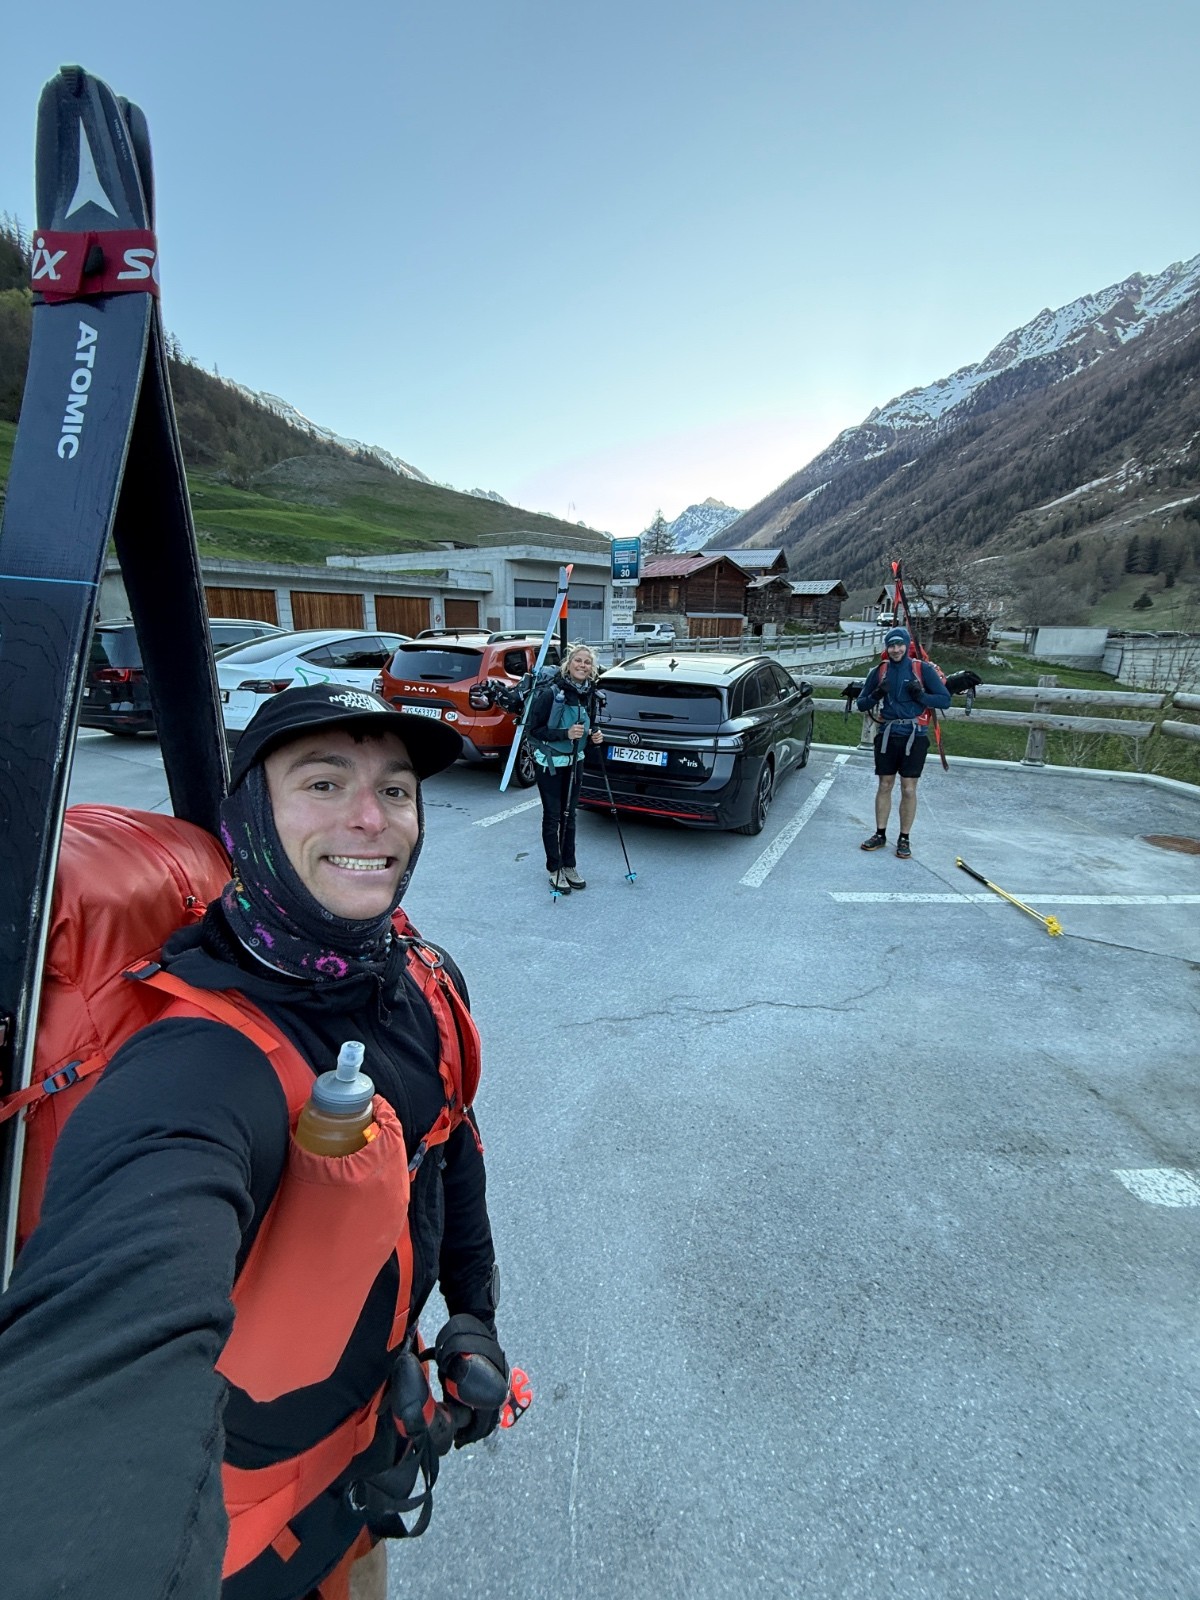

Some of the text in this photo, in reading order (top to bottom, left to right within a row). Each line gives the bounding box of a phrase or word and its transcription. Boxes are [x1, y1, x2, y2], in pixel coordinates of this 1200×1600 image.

[57, 320, 98, 460] ATOMIC
[620, 568, 631, 578] 30
[404, 685, 437, 693] DACIA
[345, 690, 368, 699] THE
[329, 694, 371, 706] NORTH
[344, 700, 373, 711] FACE
[446, 712, 456, 720] CH
[613, 747, 660, 763] HE-726-GT
